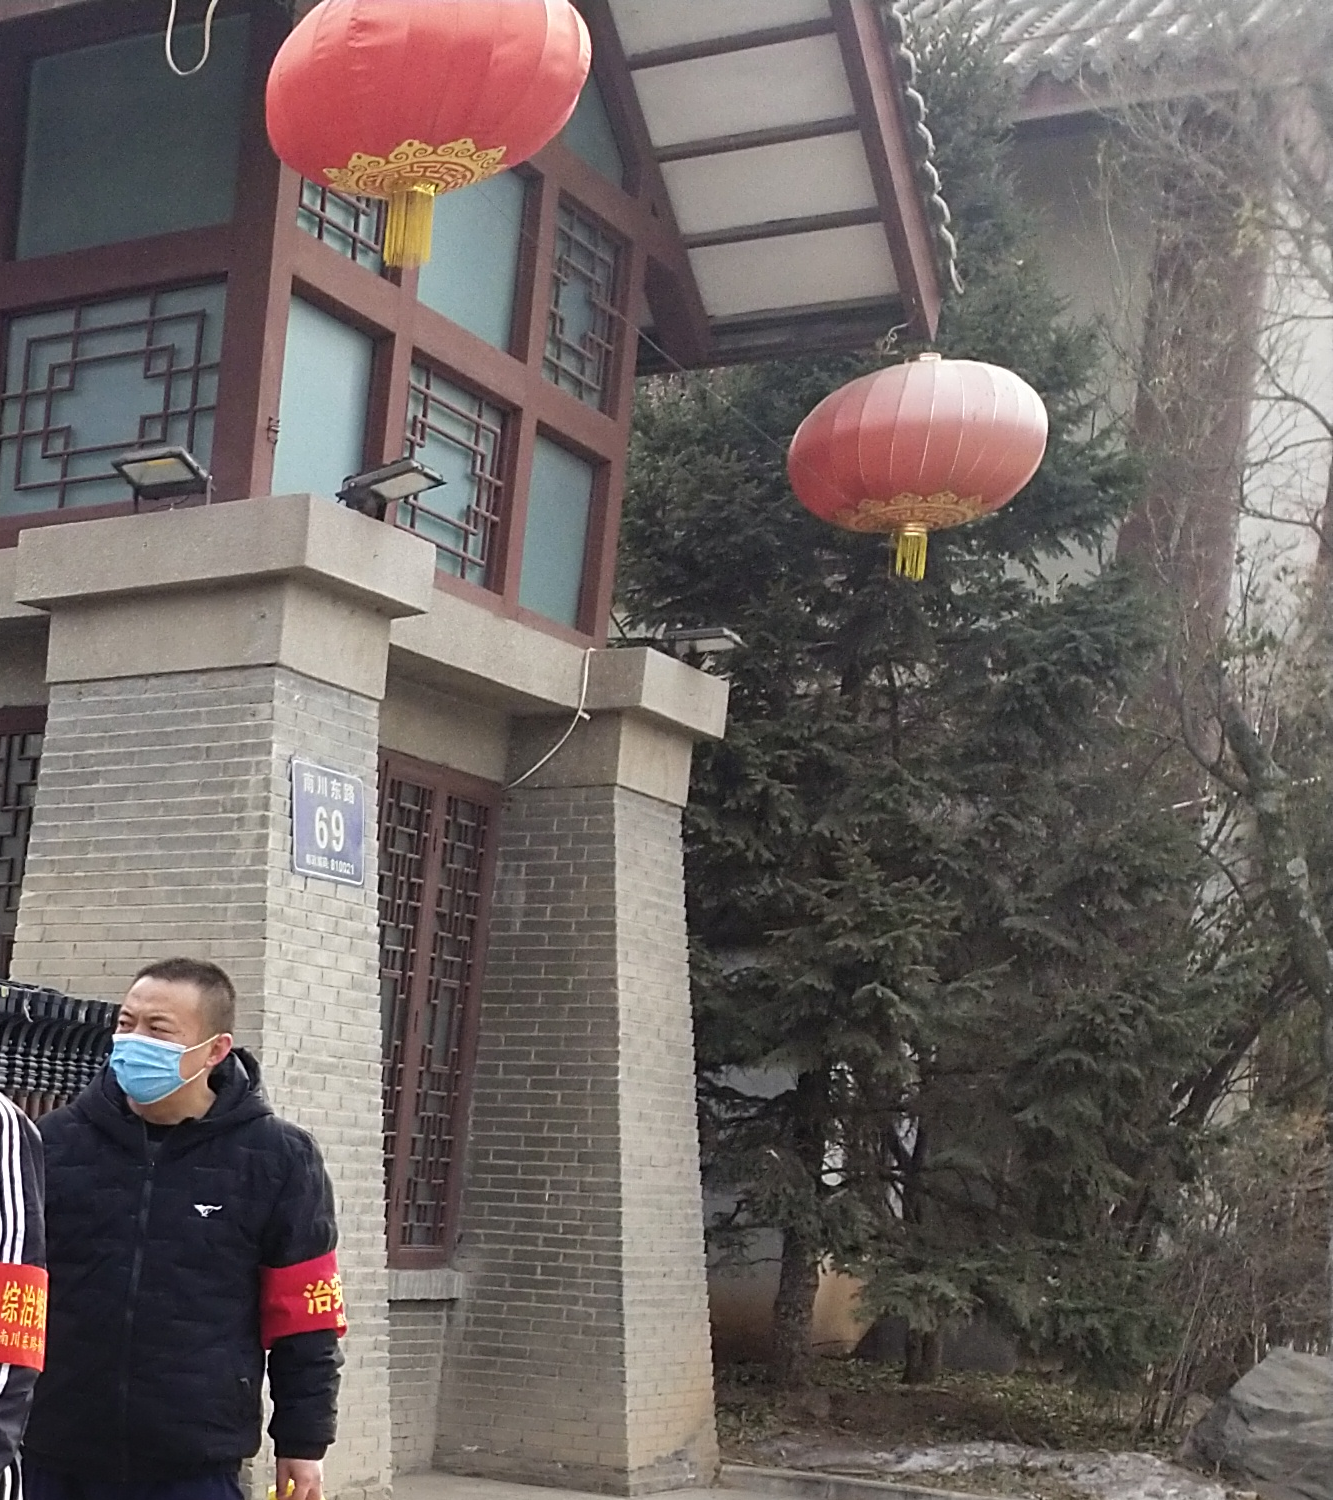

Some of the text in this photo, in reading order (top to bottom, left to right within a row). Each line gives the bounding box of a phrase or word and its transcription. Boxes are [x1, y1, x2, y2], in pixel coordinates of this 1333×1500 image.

[303, 771, 355, 805] 南川东路
[314, 805, 345, 852] 69
